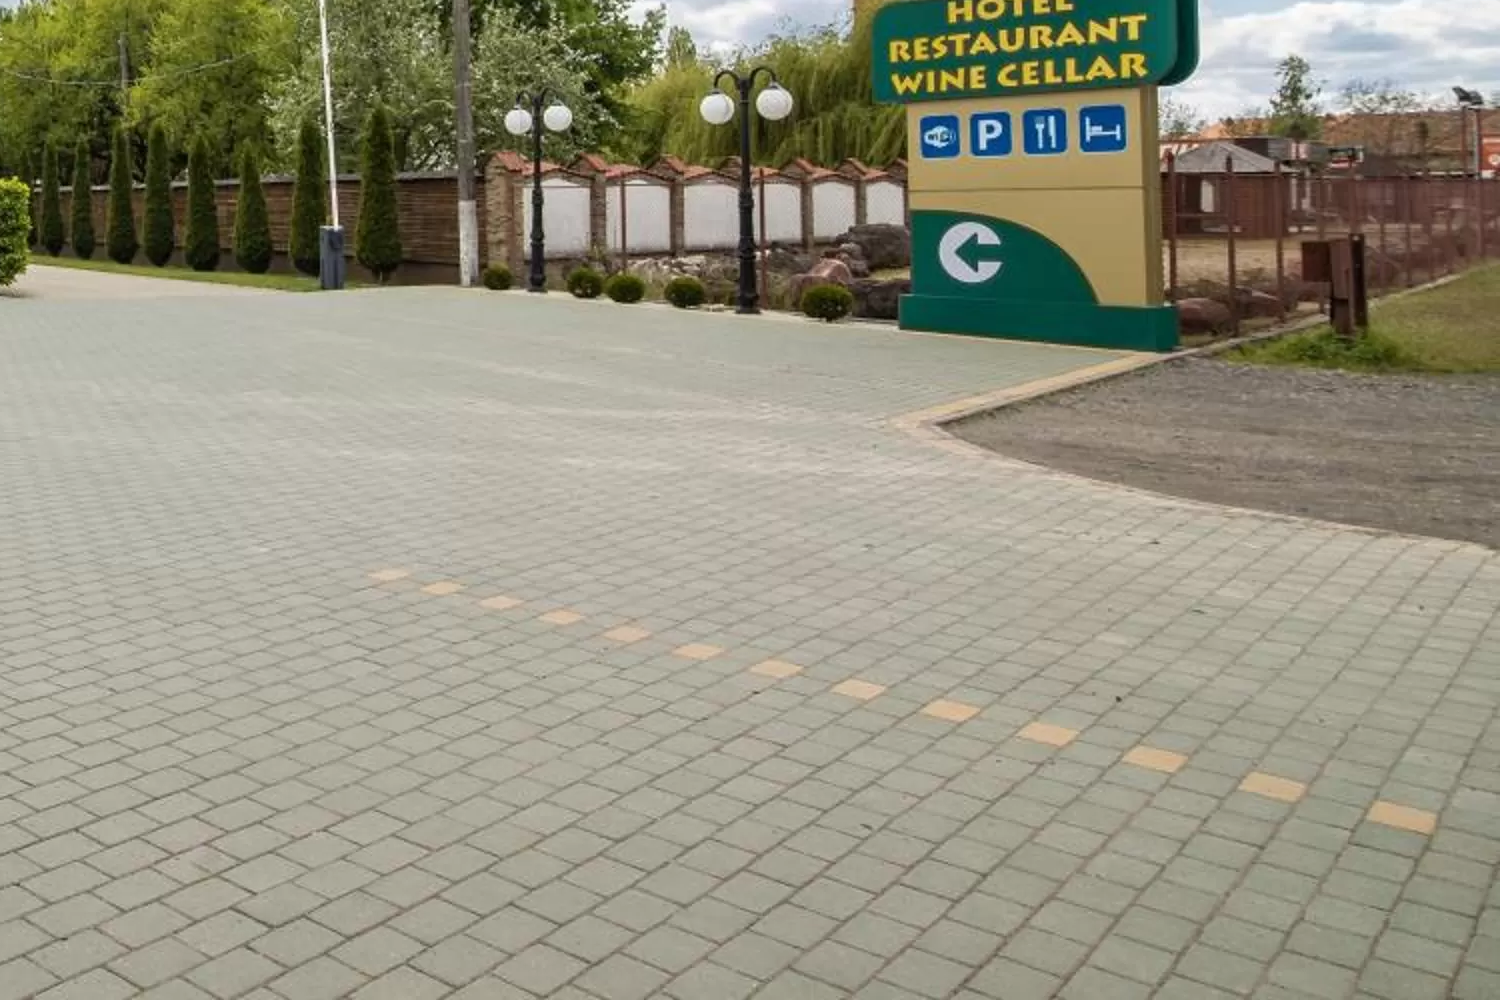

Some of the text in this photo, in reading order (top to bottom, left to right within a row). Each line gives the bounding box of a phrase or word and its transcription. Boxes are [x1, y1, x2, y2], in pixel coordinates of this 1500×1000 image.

[888, 14, 1148, 63] RESTAURANT
[891, 53, 1148, 95] WINE CELLAR
[978, 119, 1003, 151] P
